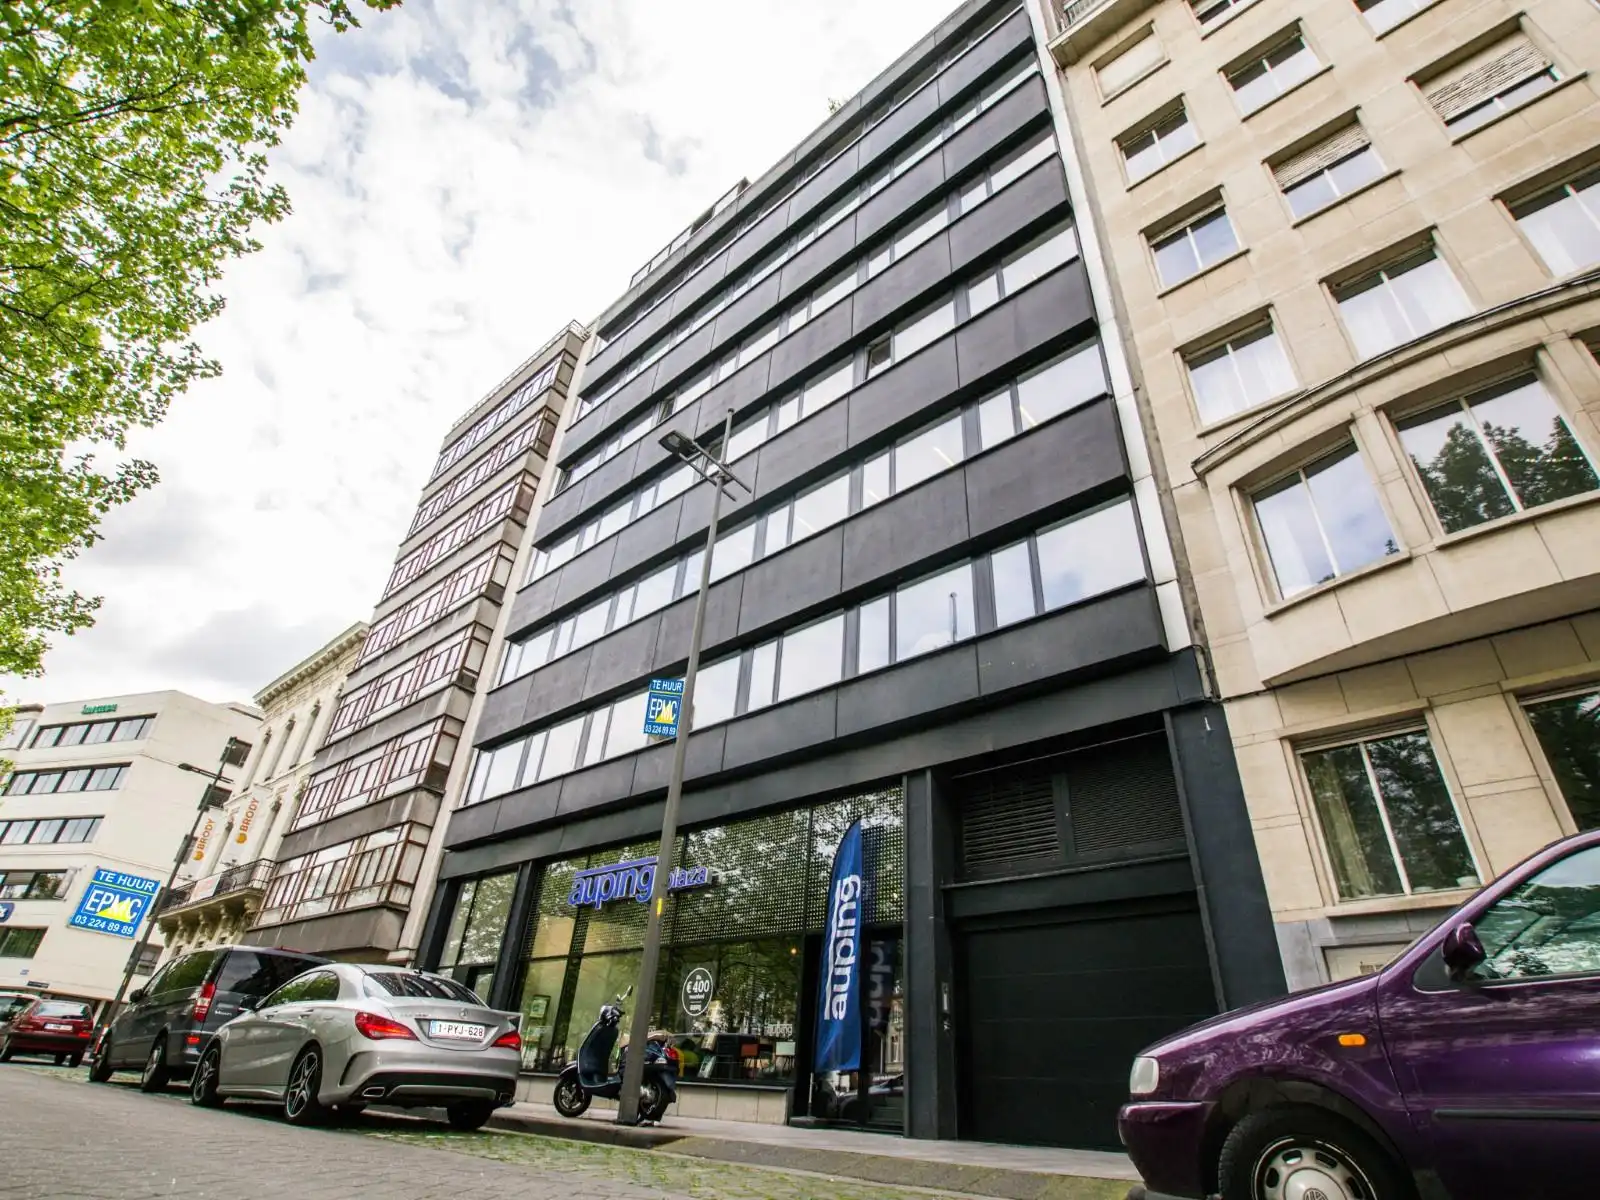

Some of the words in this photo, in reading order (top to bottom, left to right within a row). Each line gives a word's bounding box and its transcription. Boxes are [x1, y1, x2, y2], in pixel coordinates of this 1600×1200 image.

[652, 680, 661, 690] TE
[662, 680, 682, 692] HUUR
[648, 698, 679, 721] EPMC
[240, 797, 259, 832] BRODY
[196, 817, 216, 850] BRODY
[99, 870, 116, 883] TE
[117, 874, 155, 892] HUUR
[567, 856, 658, 909] auping
[85, 889, 142, 921] EPMC
[74, 915, 87, 925] 03
[88, 918, 106, 929] 224
[107, 922, 120, 932] 89
[121, 925, 134, 935] 89
[825, 874, 861, 1021] auping
[692, 979, 710, 993] 400
[438, 1023, 484, 1037] 1-PYJ-628
